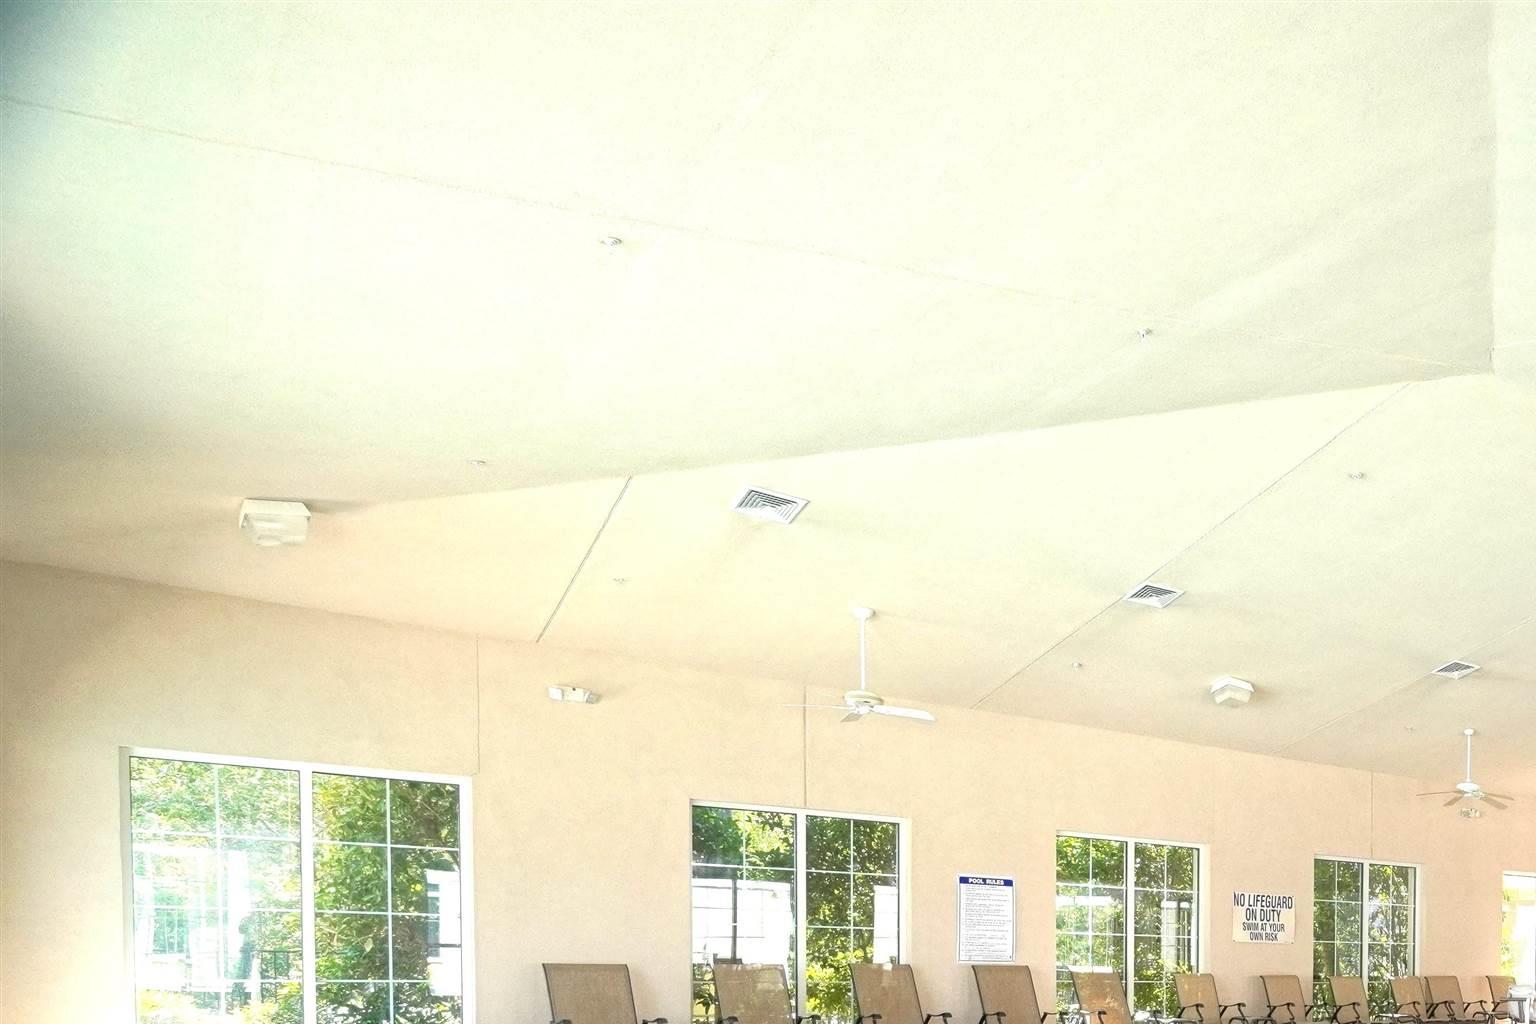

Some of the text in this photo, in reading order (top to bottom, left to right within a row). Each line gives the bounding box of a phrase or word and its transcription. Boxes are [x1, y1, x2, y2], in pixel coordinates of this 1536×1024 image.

[986, 878, 1005, 886] RULES
[1233, 891, 1293, 909] NO LIFEGUARD
[1245, 907, 1282, 922] ON DUTY
[1242, 921, 1286, 932] SWIM AT YOUR
[1249, 931, 1279, 942] OWN RISK
